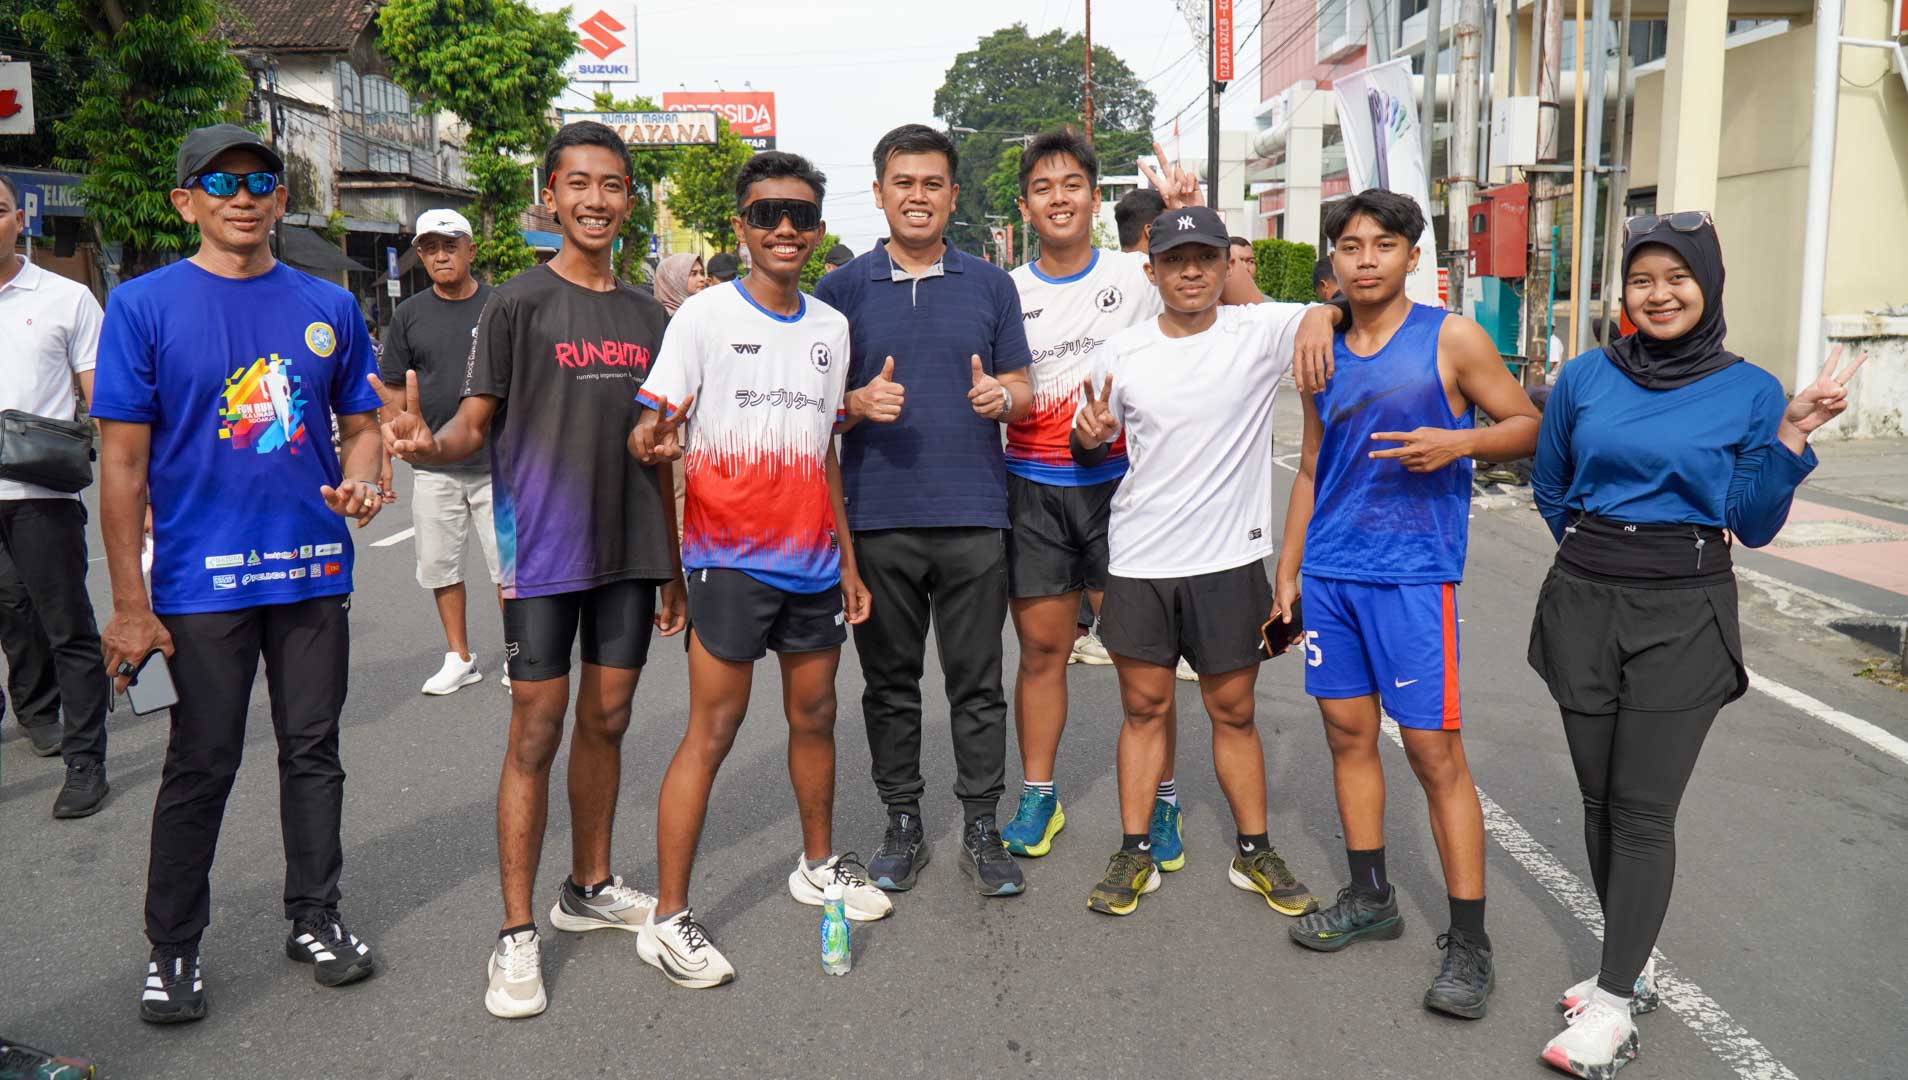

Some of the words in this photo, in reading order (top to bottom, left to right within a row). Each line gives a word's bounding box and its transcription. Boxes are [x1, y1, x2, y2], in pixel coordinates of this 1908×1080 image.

[578, 65, 628, 75] SUZUKI
[601, 113, 637, 124] RUMAH
[642, 113, 678, 123] MAKAN
[25, 192, 38, 228] P
[576, 373, 599, 381] running
